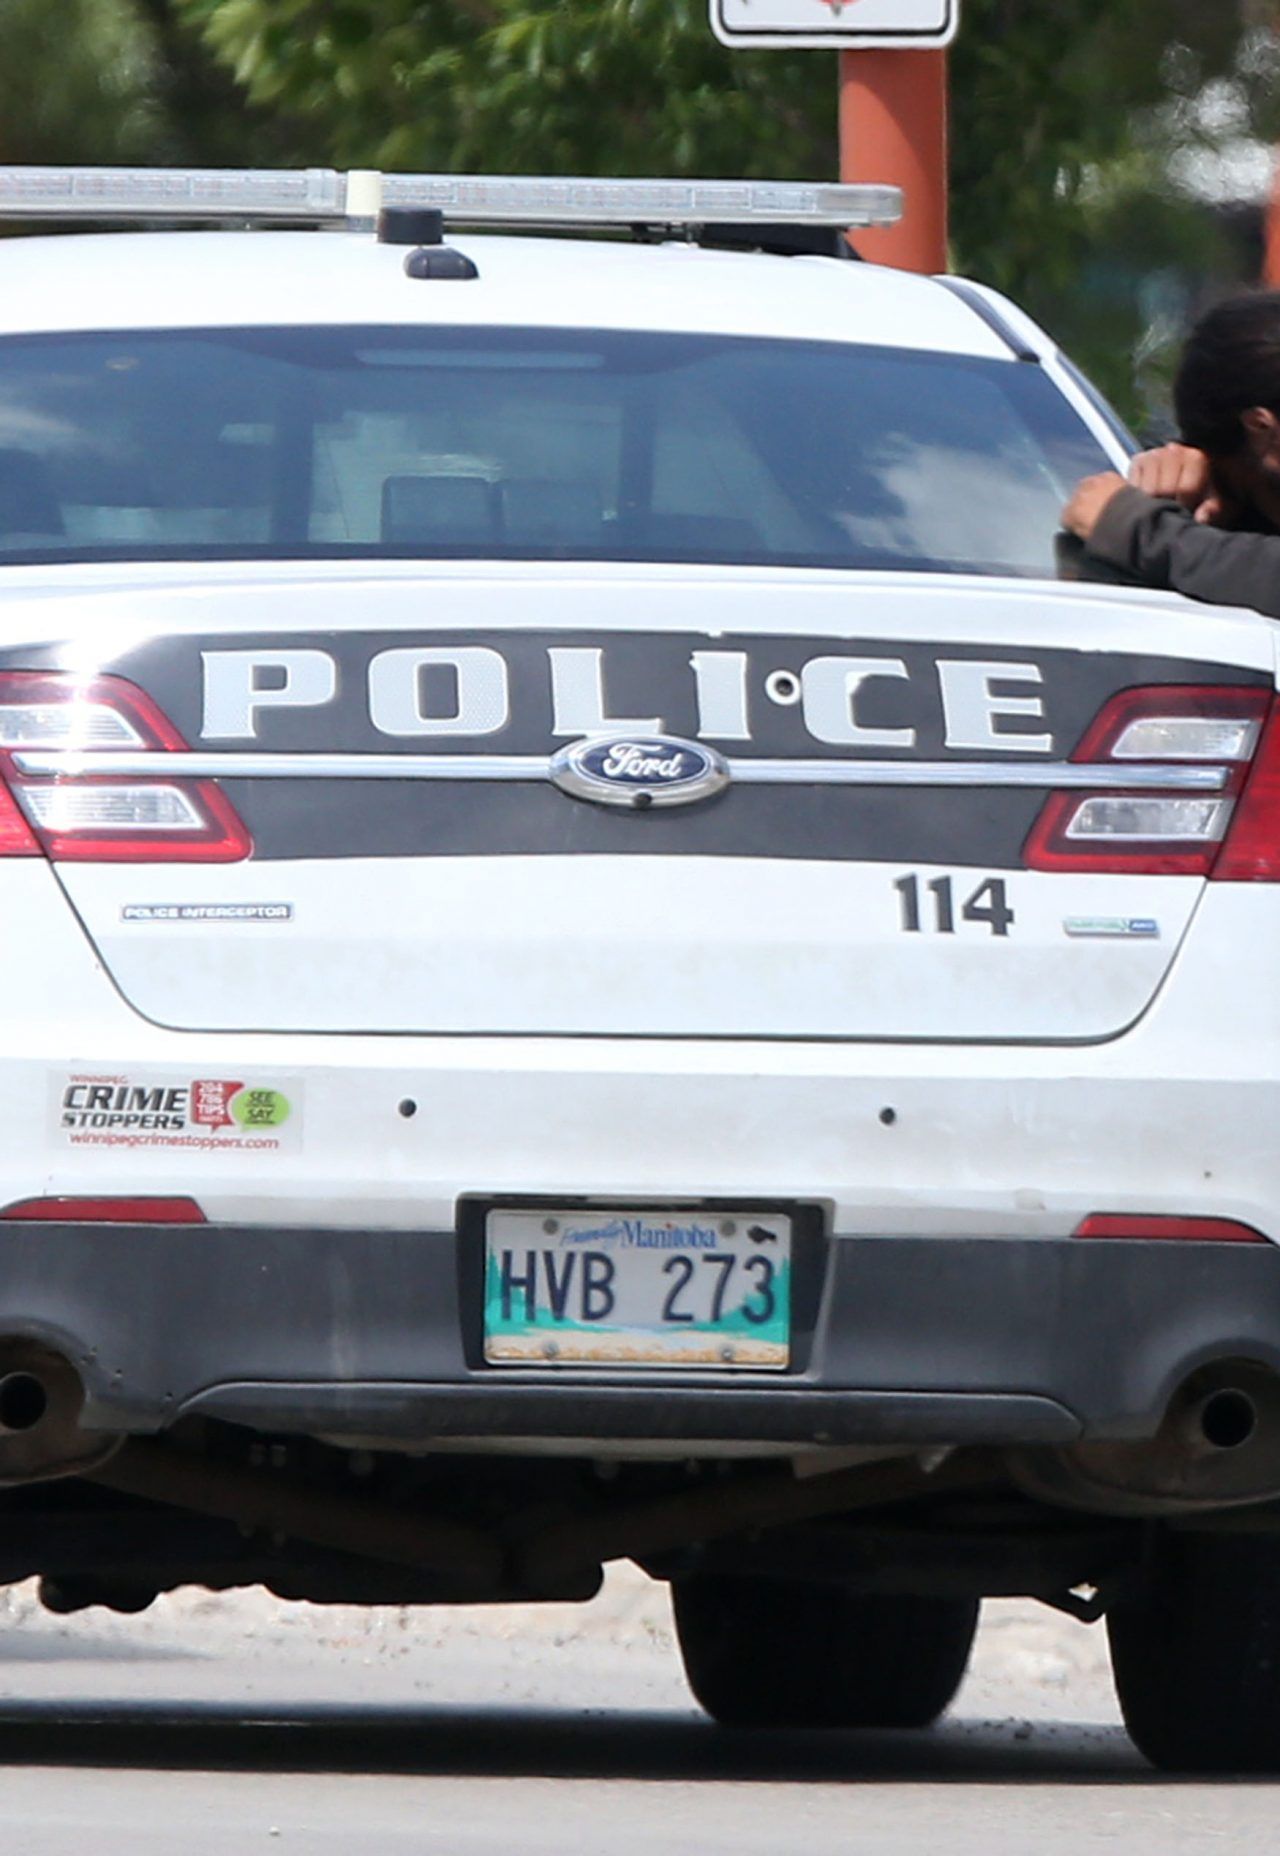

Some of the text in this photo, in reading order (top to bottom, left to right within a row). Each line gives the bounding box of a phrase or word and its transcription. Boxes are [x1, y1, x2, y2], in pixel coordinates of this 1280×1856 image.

[200, 646, 1053, 751] POLICE
[602, 743, 683, 777] Ford
[125, 905, 287, 919] POLICE INTERCEPTOR
[892, 872, 1015, 936] 114
[62, 1085, 187, 1112] CRIME
[61, 1111, 185, 1130] STOPPERS
[70, 1131, 279, 1150] winnipegcrimestoppers.com
[621, 1220, 717, 1249] Manitoba
[501, 1249, 775, 1324] HVB 273
